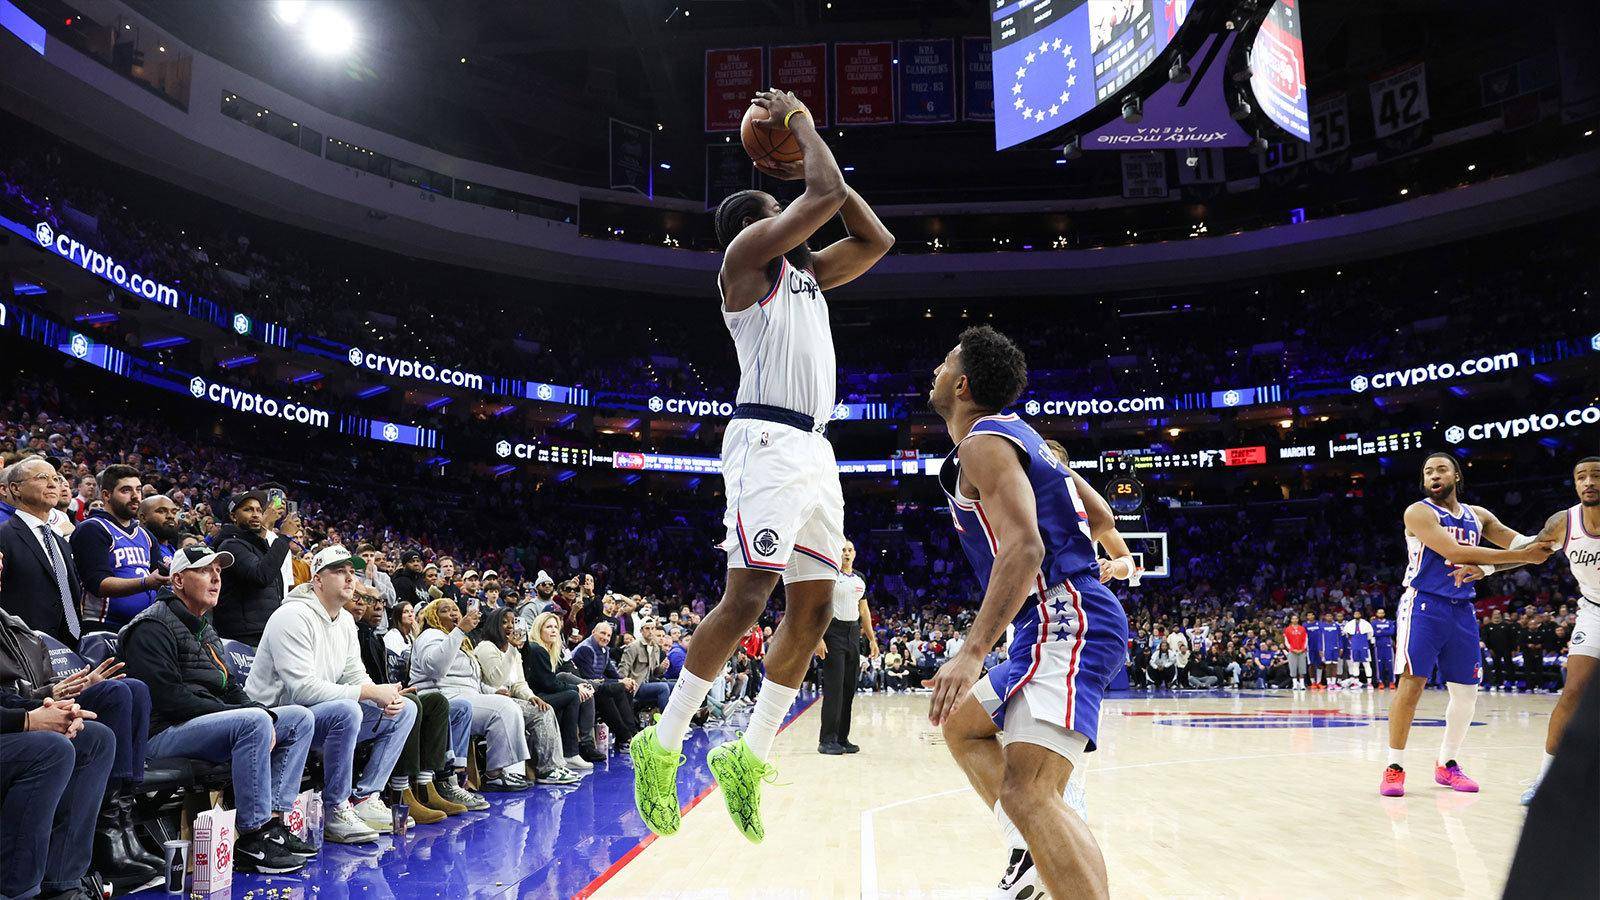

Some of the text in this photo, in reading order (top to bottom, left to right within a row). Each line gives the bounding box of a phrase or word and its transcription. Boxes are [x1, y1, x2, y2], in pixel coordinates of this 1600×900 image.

[914, 54, 940, 66] WORLD
[905, 65, 949, 75] CHAMPIONS
[1380, 81, 1422, 129] 42
[1097, 131, 1227, 144] xfinity mobile
[1313, 110, 1345, 154] 35
[57, 234, 179, 308] crypto.com
[365, 354, 483, 390] crypto.com
[1372, 353, 1519, 386] crypto.com
[208, 383, 329, 428] crypto.com
[666, 398, 735, 416] crypto.
[1043, 397, 1164, 415] crypto.com
[1468, 406, 1600, 440] crypto.co
[515, 444, 535, 459] cr
[1280, 445, 1316, 458] MARCH 12
[1069, 460, 1098, 469] CLIPPERS
[113, 547, 151, 568] PHIL
[1569, 550, 1600, 569] Clipp
[48, 648, 74, 656] nsurance
